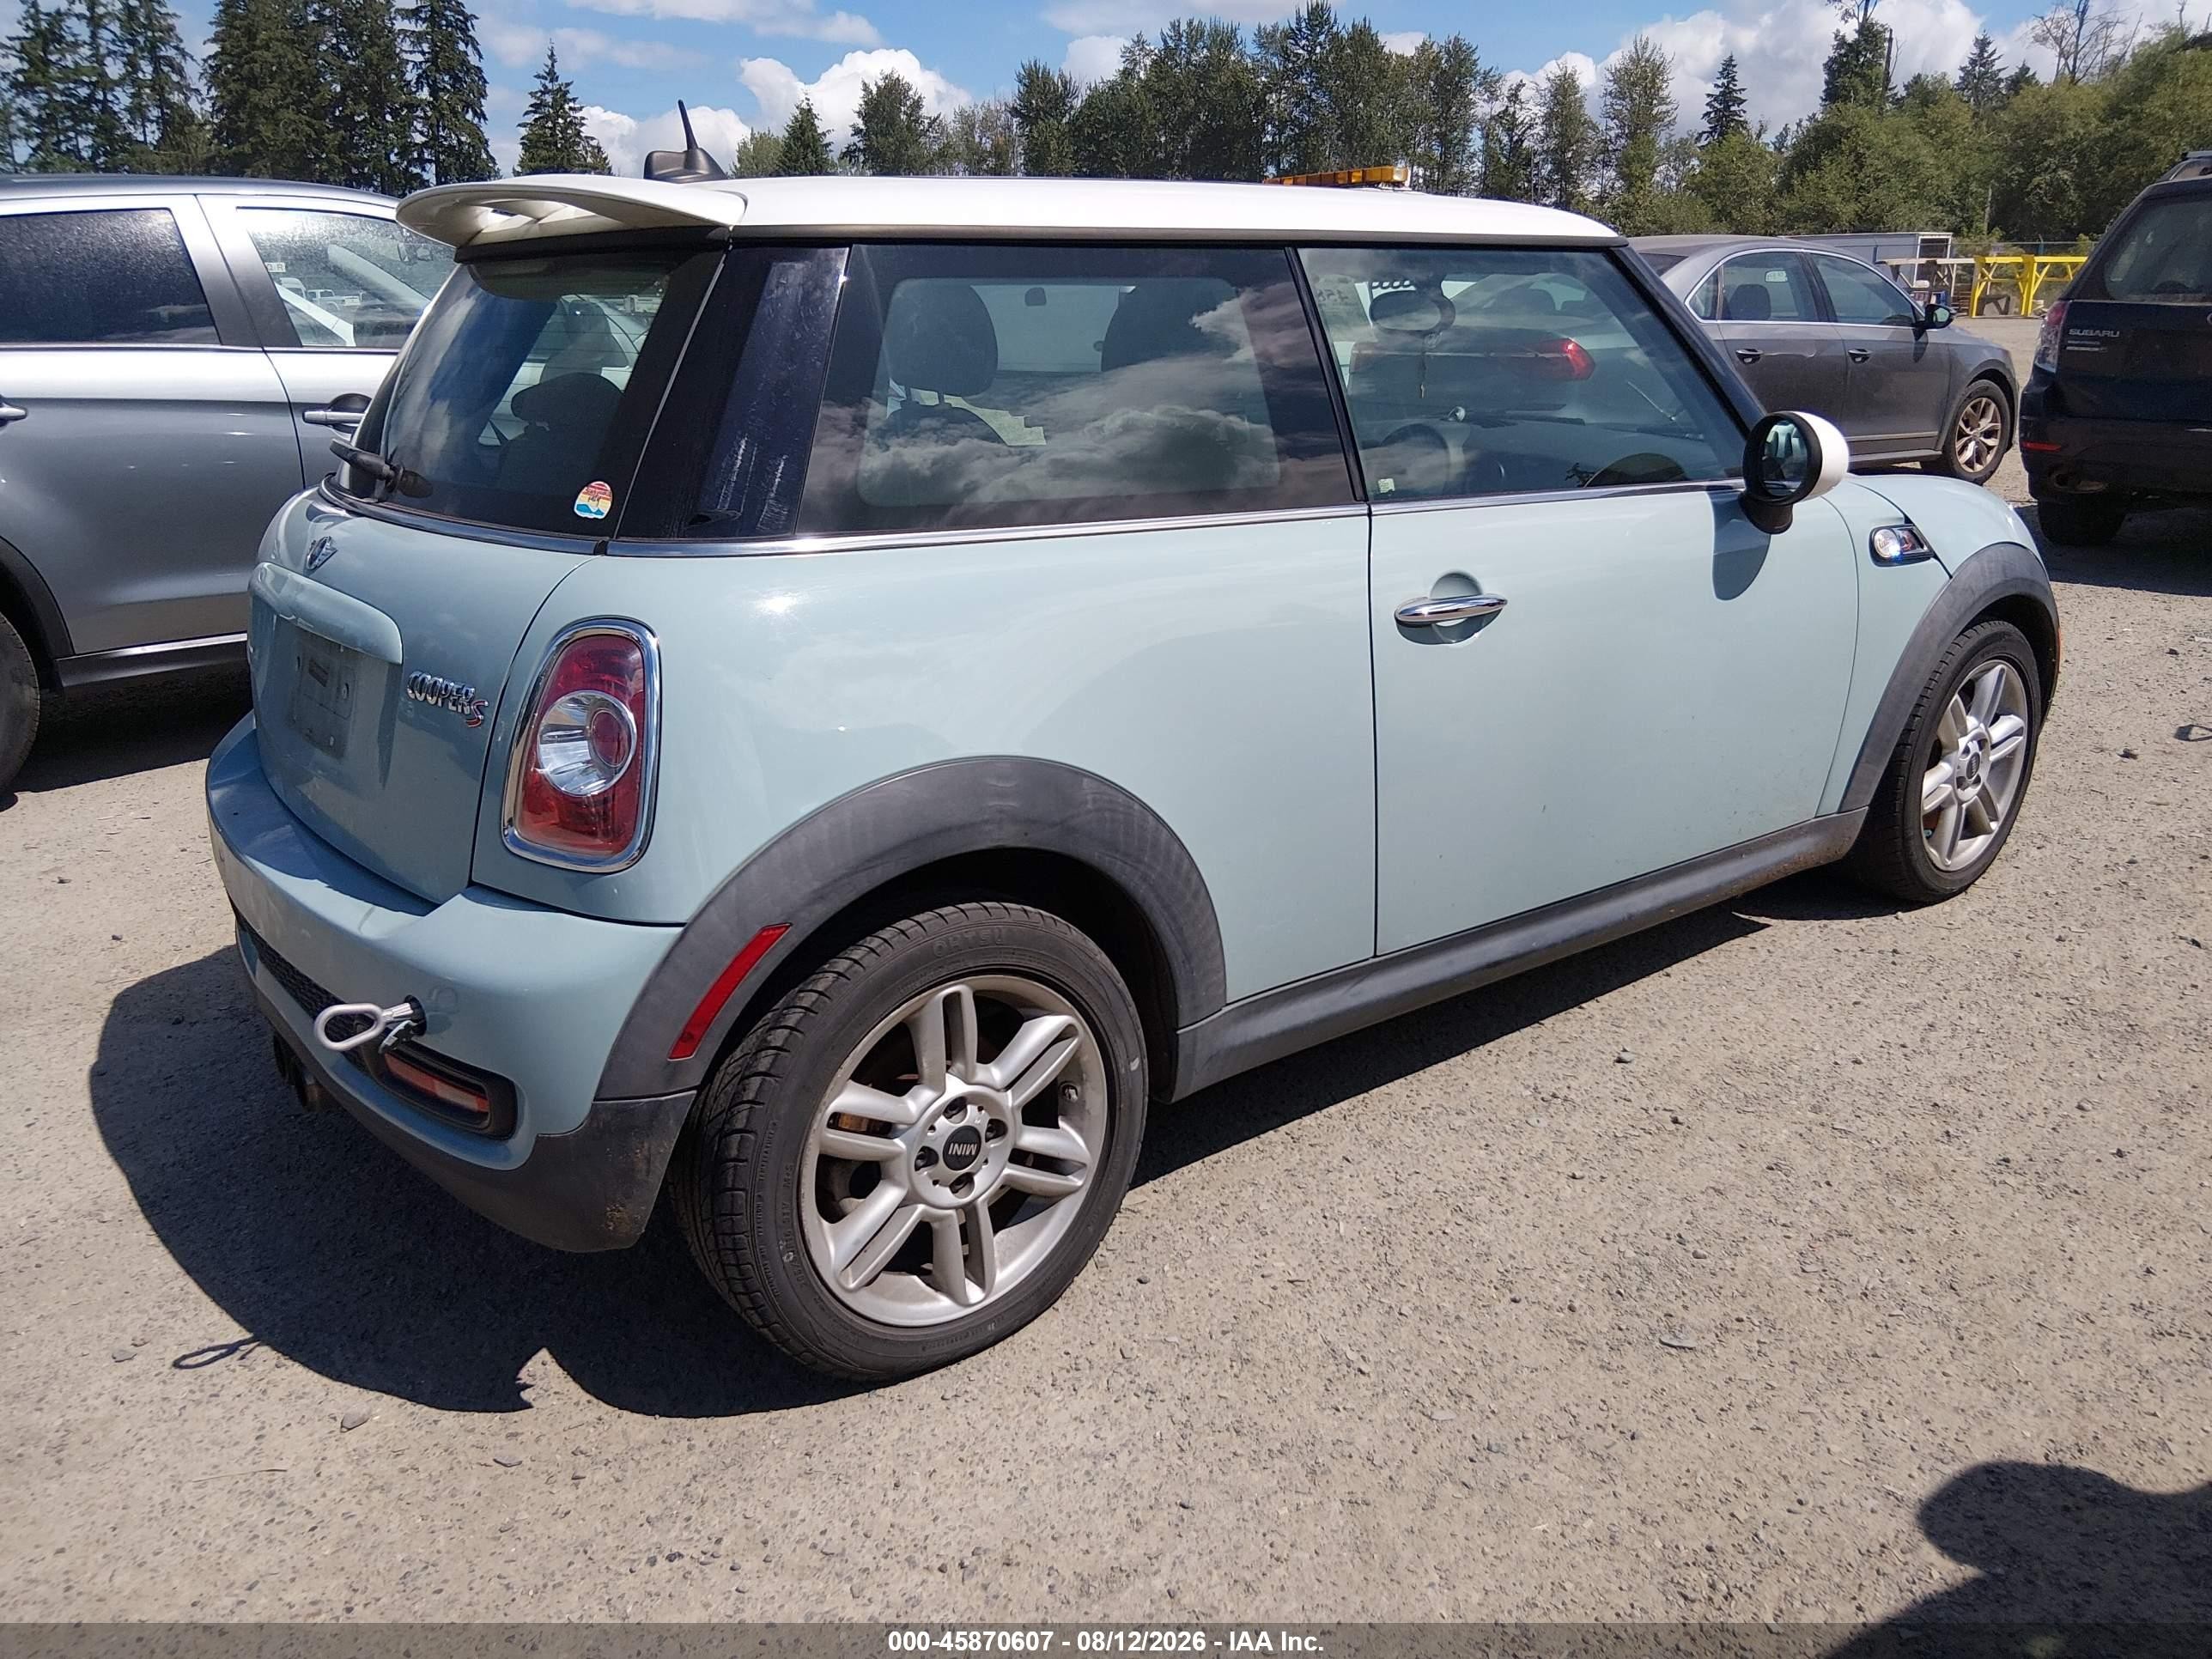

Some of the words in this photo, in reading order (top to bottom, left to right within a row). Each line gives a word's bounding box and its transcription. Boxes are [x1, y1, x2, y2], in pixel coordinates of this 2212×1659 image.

[2068, 329, 2120, 337] SUBARU
[407, 670, 475, 714] COOPER
[464, 699, 489, 727] S
[948, 1142, 977, 1156] MINI
